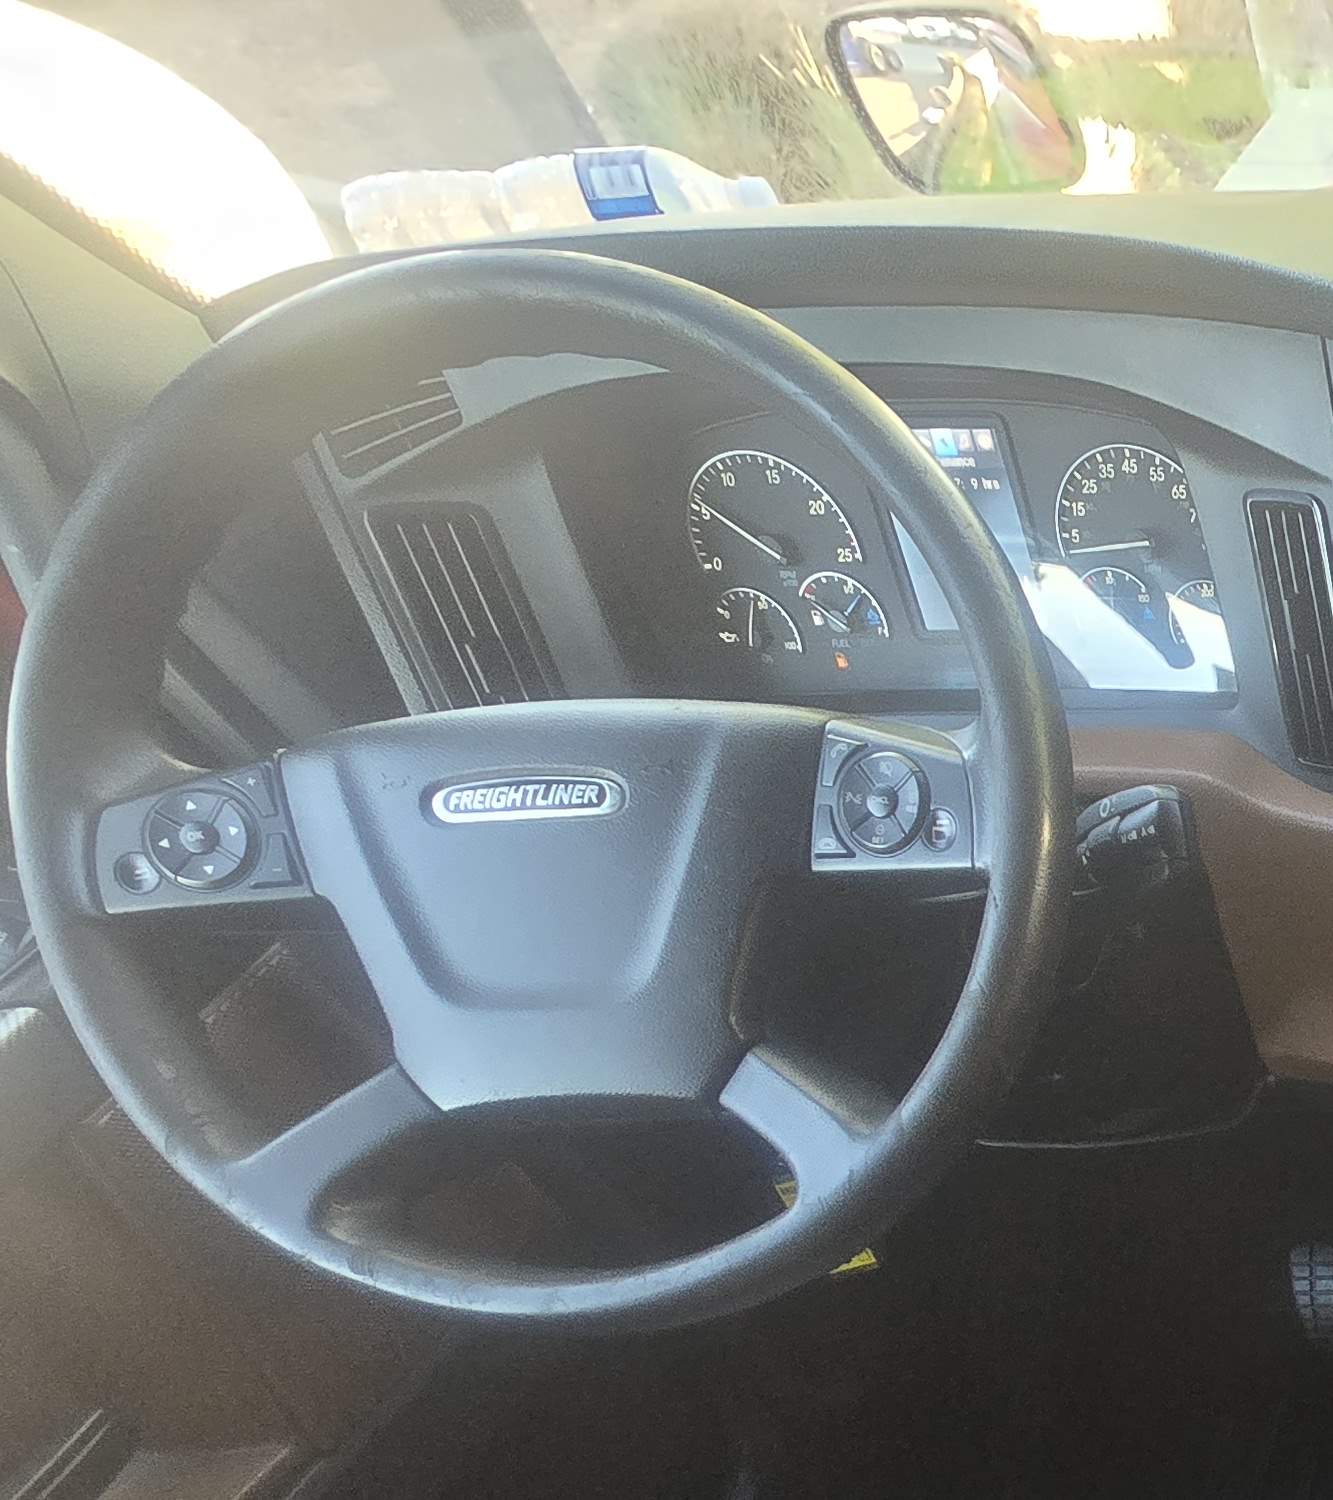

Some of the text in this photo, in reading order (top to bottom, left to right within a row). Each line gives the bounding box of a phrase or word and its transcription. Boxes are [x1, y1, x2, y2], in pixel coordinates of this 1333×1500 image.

[1099, 464, 1115, 479] 35
[1122, 459, 1138, 474] 45
[721, 472, 736, 487] 10
[766, 469, 781, 485] 15
[1150, 467, 1165, 482] 55
[1082, 479, 1098, 494] 25
[1171, 485, 1187, 500] 65
[701, 506, 711, 520] 5
[808, 500, 825, 515] 20
[1072, 502, 1086, 516] 15
[1189, 508, 1197, 523] 7
[1071, 529, 1080, 543] 5
[837, 548, 853, 563] 25
[713, 557, 722, 571] 0
[832, 638, 851, 648] FUEL
[448, 783, 600, 811] FREIGHTLINER
